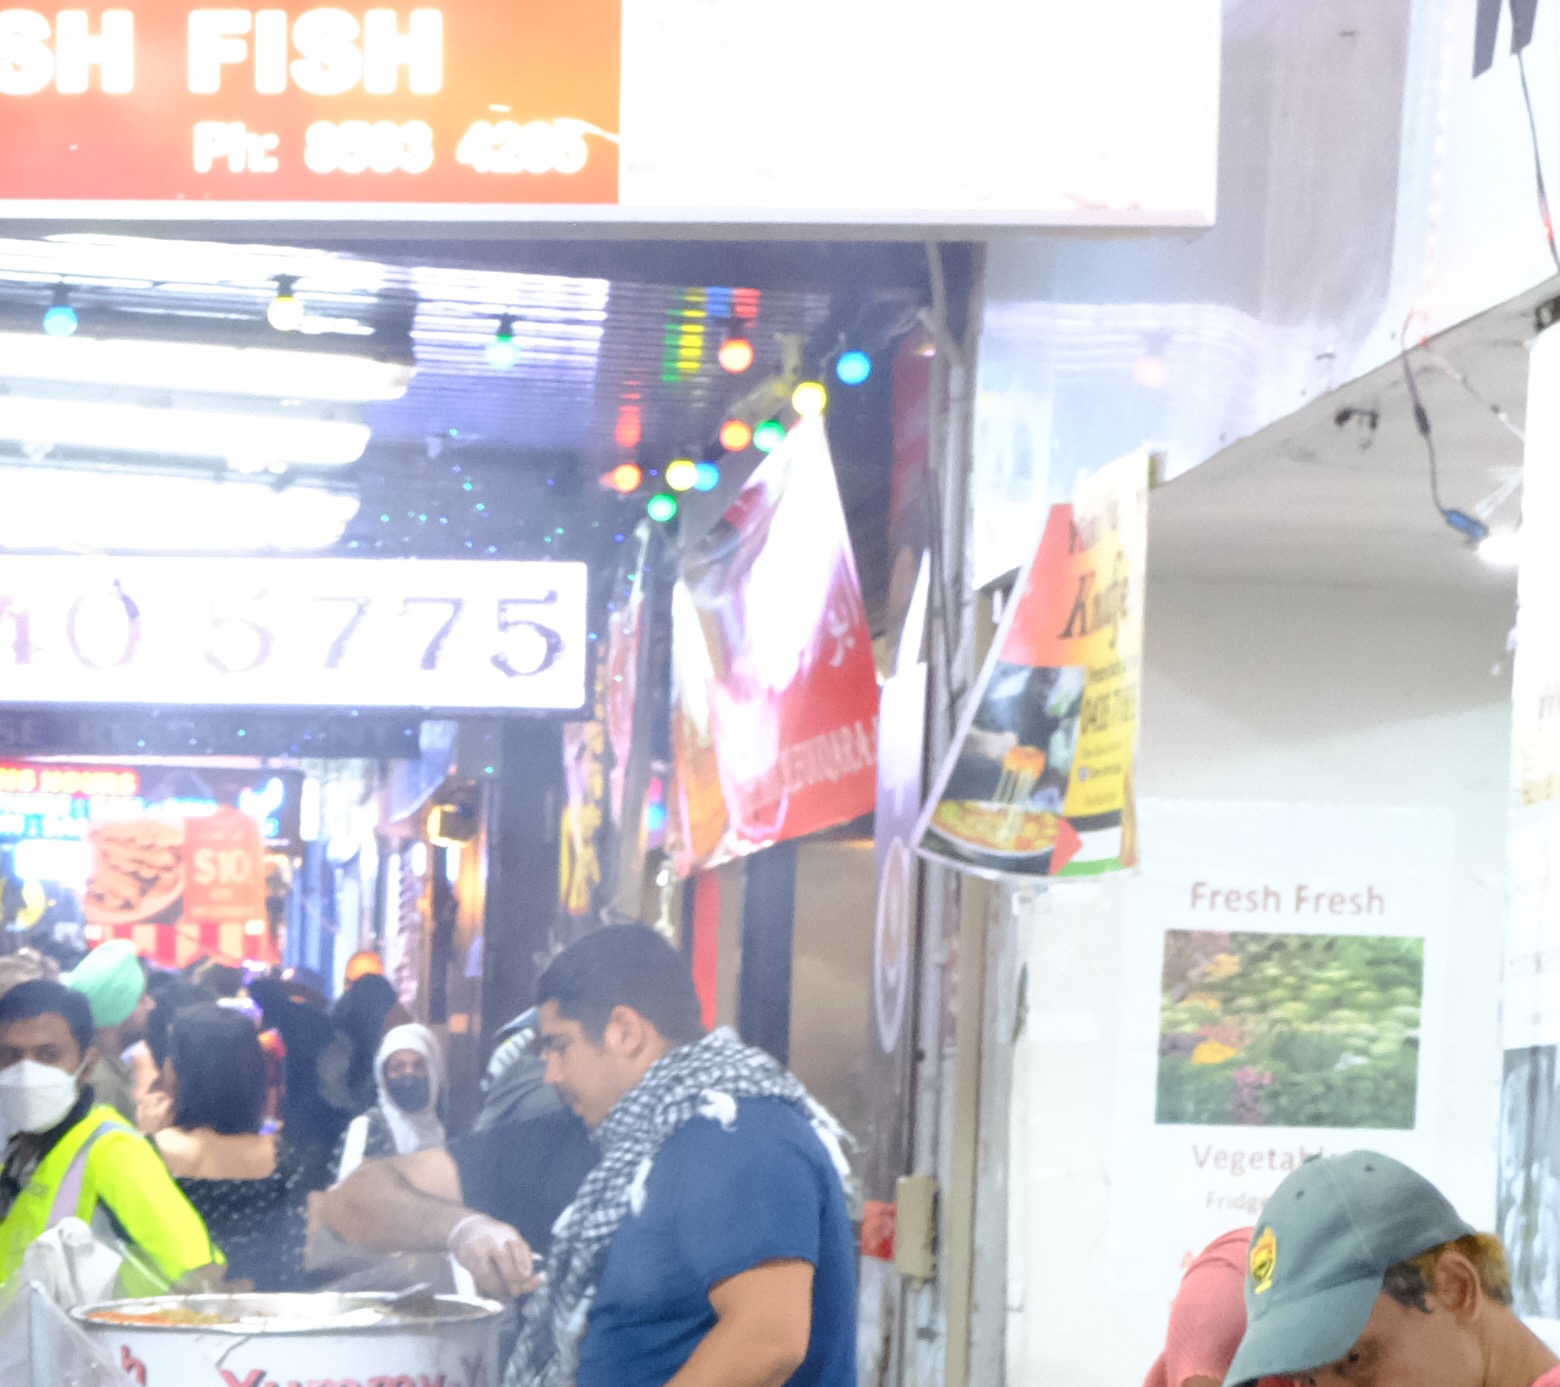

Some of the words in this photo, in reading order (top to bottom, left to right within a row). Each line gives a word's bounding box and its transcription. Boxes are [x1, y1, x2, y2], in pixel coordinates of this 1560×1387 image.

[186, 9, 443, 97] FISH
[203, 587, 566, 677] 5775
[194, 848, 251, 886] $10
[1190, 882, 1281, 914] Fresh
[1294, 885, 1385, 916] Fresh
